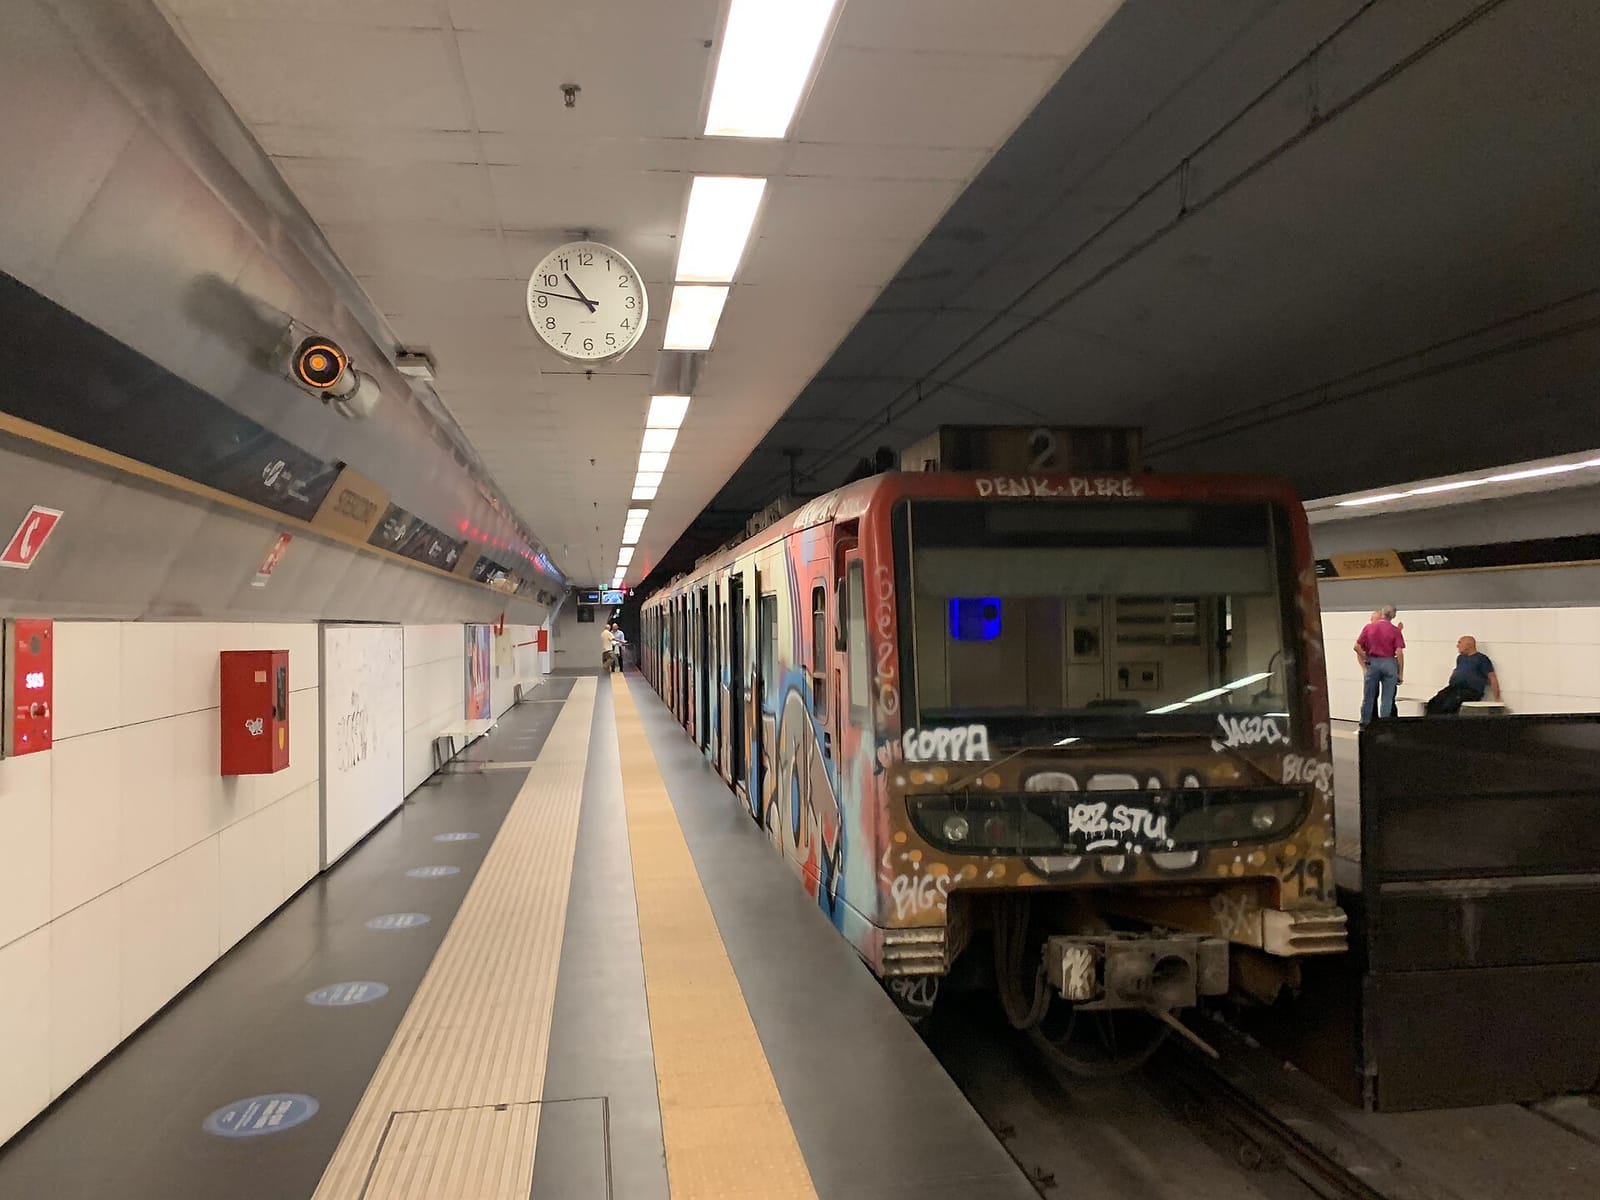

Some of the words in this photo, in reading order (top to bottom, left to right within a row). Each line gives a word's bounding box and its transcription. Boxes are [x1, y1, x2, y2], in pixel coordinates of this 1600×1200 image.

[559, 259, 569, 271] 11
[577, 253, 593, 266] 12
[543, 274, 558, 287] 10
[618, 275, 629, 288] 2
[537, 295, 548, 308] 9
[625, 296, 636, 309] 3
[545, 316, 556, 330] 8
[619, 318, 630, 330] 4
[561, 332, 572, 345] 7
[583, 338, 594, 351] 6
[605, 332, 616, 346] 5
[26, 672, 45, 689] SOS
